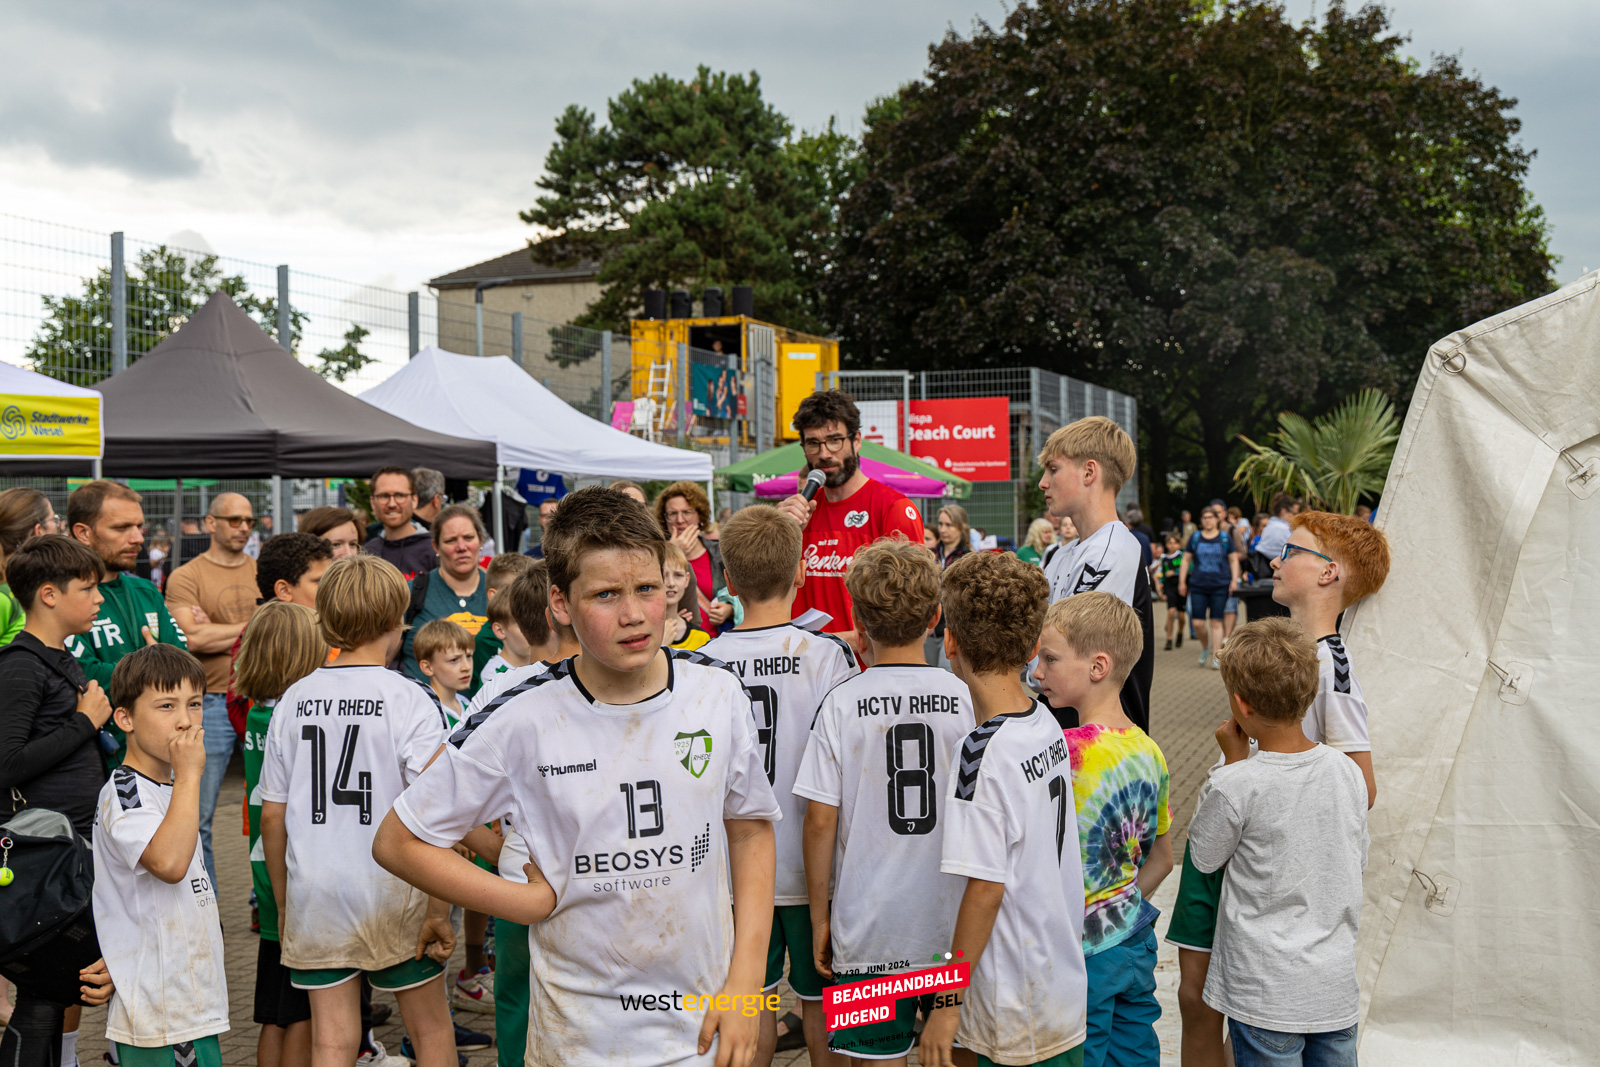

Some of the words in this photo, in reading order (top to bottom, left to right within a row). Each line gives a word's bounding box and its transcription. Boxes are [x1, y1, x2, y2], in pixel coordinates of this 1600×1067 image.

[30, 411, 89, 425] Stadtwerke
[30, 424, 65, 437] Wesel
[952, 425, 996, 440] Court
[88, 623, 125, 649] TR
[754, 656, 801, 677] RHEDE
[296, 699, 333, 718] HCTV
[338, 699, 384, 717] RHEDE
[857, 695, 902, 718] HCTV
[909, 694, 959, 715] RHEDE
[674, 740, 690, 749] 1925
[693, 752, 712, 761] RHEDE
[1020, 749, 1051, 784] HCTV
[301, 724, 372, 826] 14
[550, 759, 597, 776] hummel
[886, 723, 938, 835] 8
[620, 779, 665, 840] 13
[574, 845, 684, 875] BEOSYS
[593, 875, 671, 892] software
